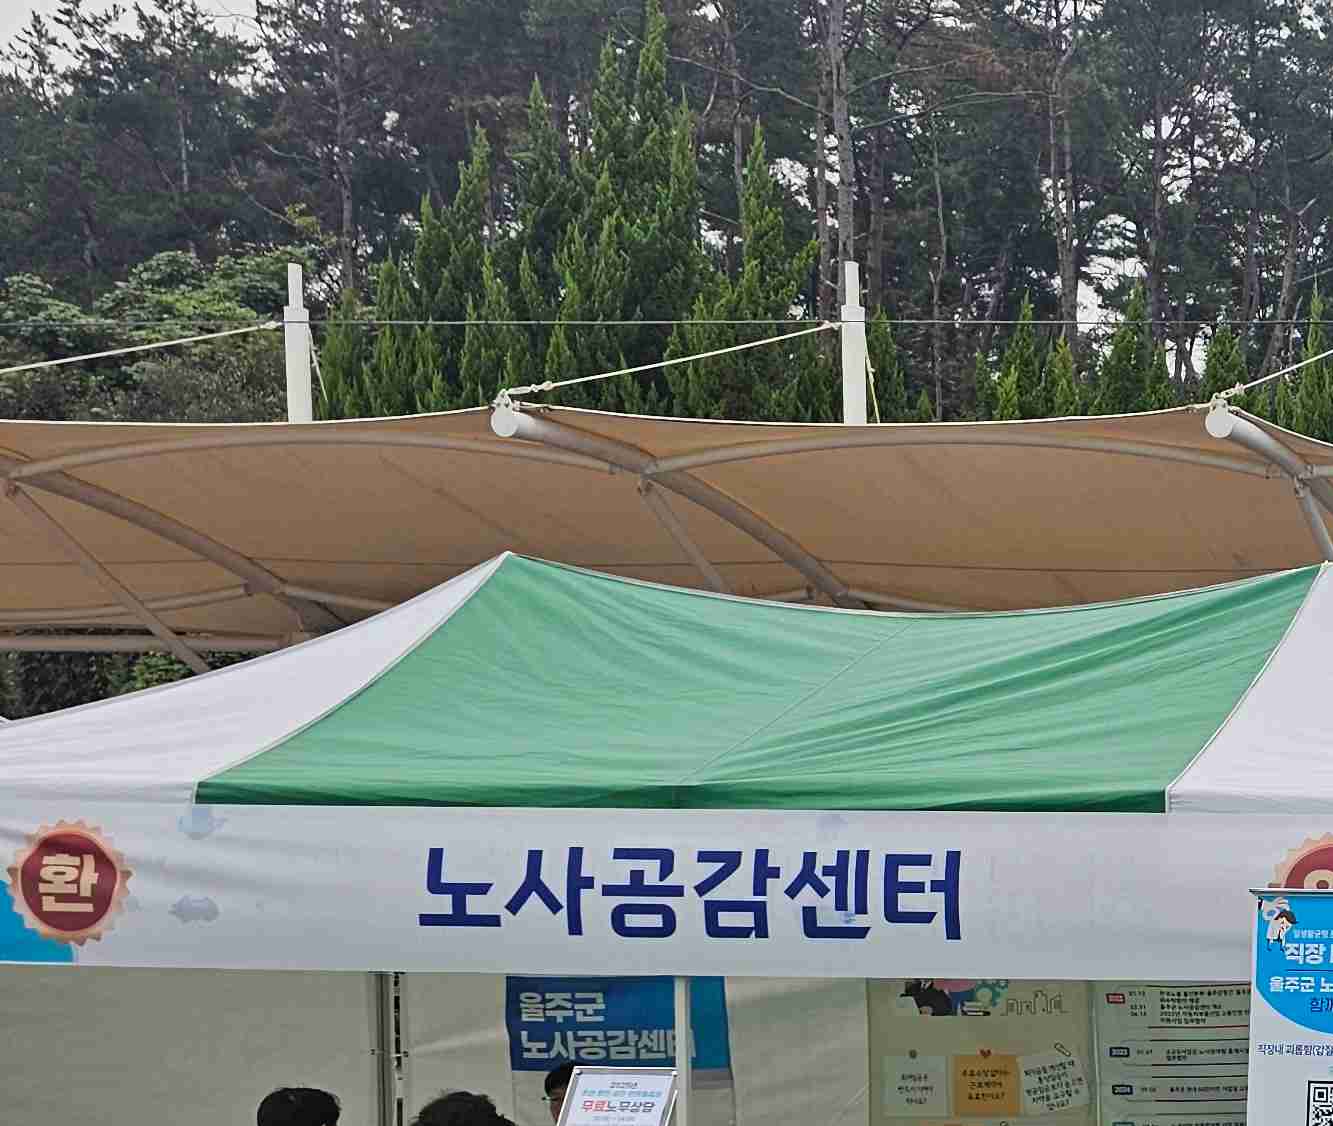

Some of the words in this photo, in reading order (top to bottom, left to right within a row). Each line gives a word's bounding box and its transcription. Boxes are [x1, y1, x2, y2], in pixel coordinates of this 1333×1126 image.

[37, 854, 99, 914] 환
[418, 845, 963, 941] 노사공감센터
[1284, 942, 1326, 965] 직장
[1269, 975, 1315, 993] 울주군
[519, 991, 606, 1024] 울주군
[1257, 1044, 1284, 1057] 직장내
[582, 1099, 656, 1113] 무료노무상담
